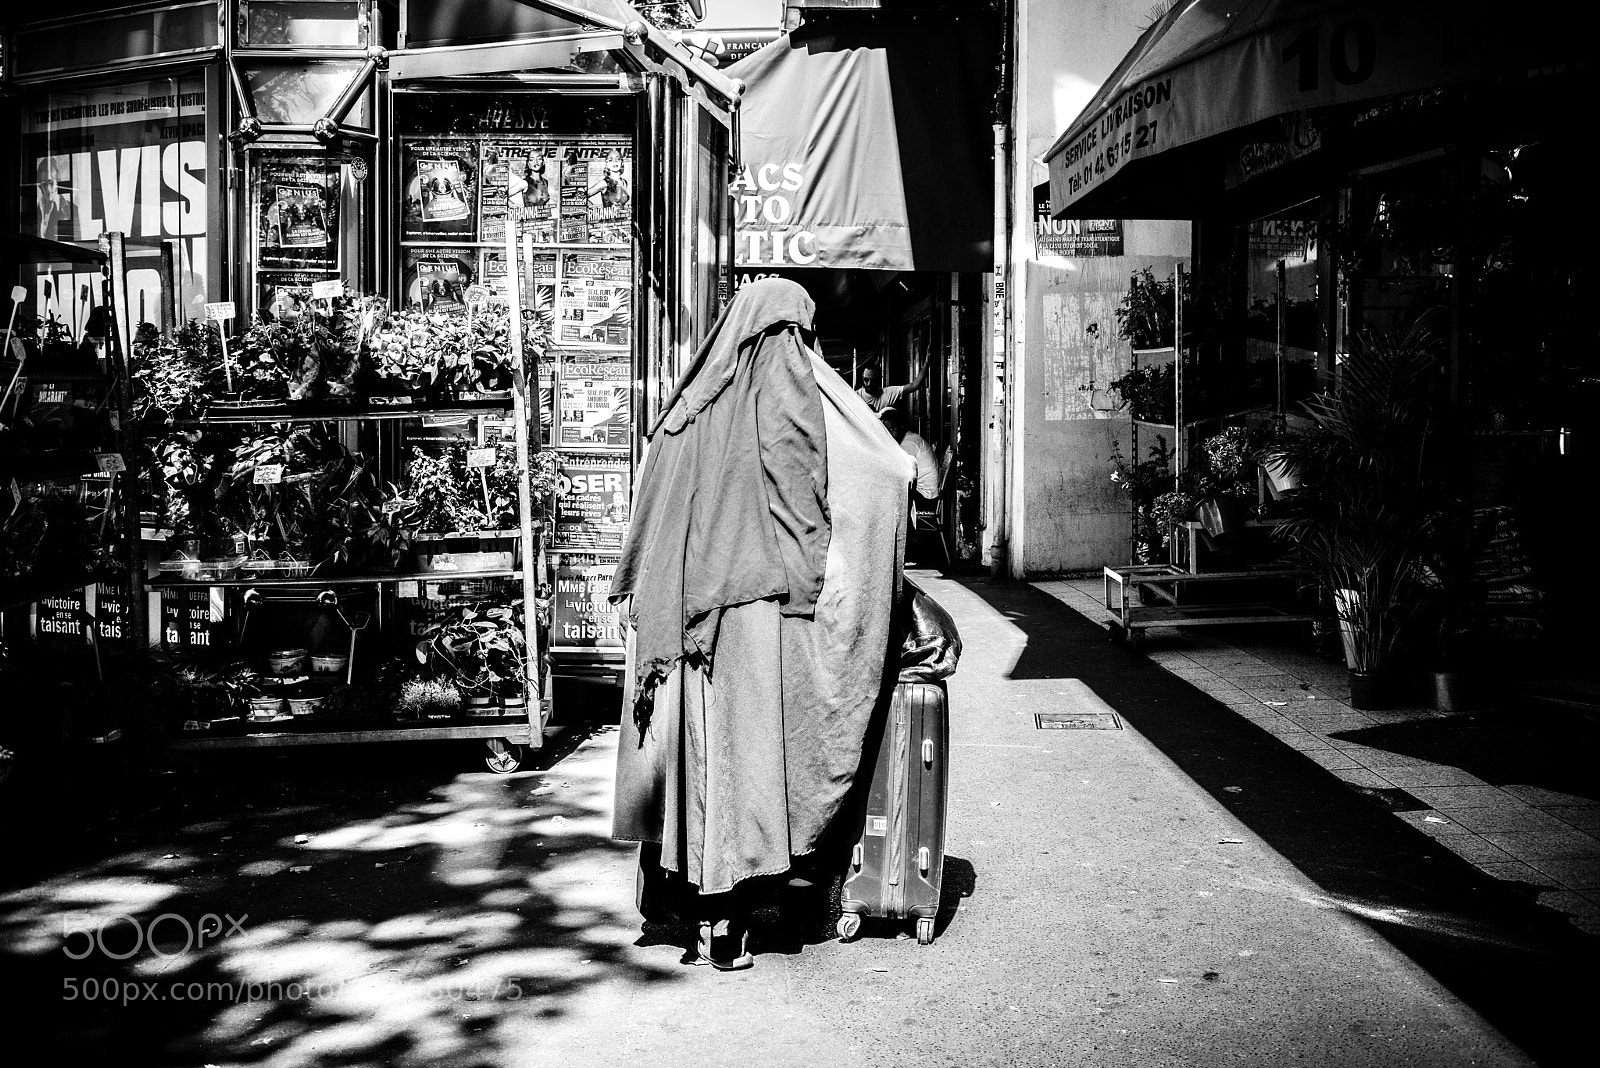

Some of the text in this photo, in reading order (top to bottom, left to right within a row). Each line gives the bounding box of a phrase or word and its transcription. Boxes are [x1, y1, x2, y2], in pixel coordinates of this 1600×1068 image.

[98, 103, 109, 117] LES
[110, 101, 125, 116] PLUS
[1065, 78, 1171, 169] SERVICE LIVRAISON
[1083, 162, 1092, 185] 01
[1094, 152, 1105, 176] 42
[1135, 119, 1157, 150] 27
[36, 140, 207, 242] ELVIS
[509, 205, 539, 222] RIHANNA
[588, 205, 618, 222] RIHANNA
[1039, 214, 1081, 235] NON
[420, 265, 457, 273] GENIUS
[567, 262, 632, 276] EcoRéseau
[565, 363, 631, 377] EcoRéseau
[561, 456, 631, 468] Entreprendre
[555, 473, 623, 495] OSER
[47, 596, 81, 610] victoire
[56, 611, 72, 620] en se
[588, 615, 613, 624] en se
[40, 616, 81, 635] taisant
